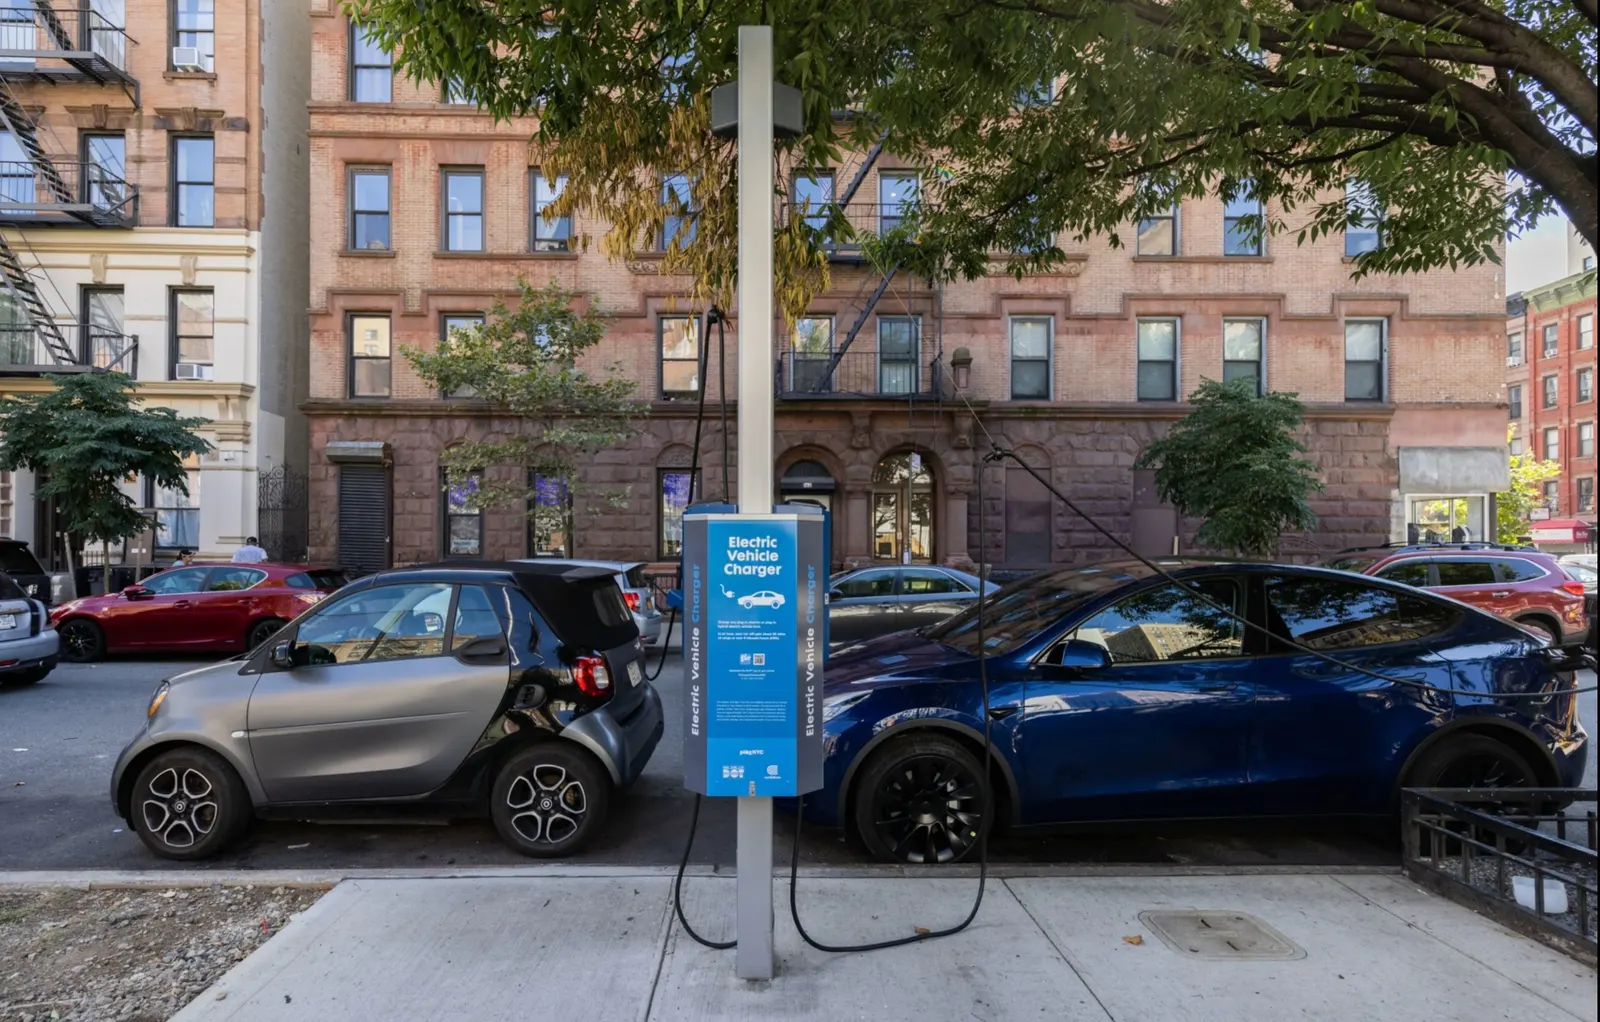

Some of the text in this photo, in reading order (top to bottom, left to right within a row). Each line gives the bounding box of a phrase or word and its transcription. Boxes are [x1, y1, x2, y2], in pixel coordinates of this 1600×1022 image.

[728, 535, 778, 548] Electric
[727, 549, 779, 562] Vehicle
[724, 563, 782, 577] Charger
[691, 564, 701, 736] Electric Vehicle Charger
[805, 564, 816, 736] Electric Vehicle Charger
